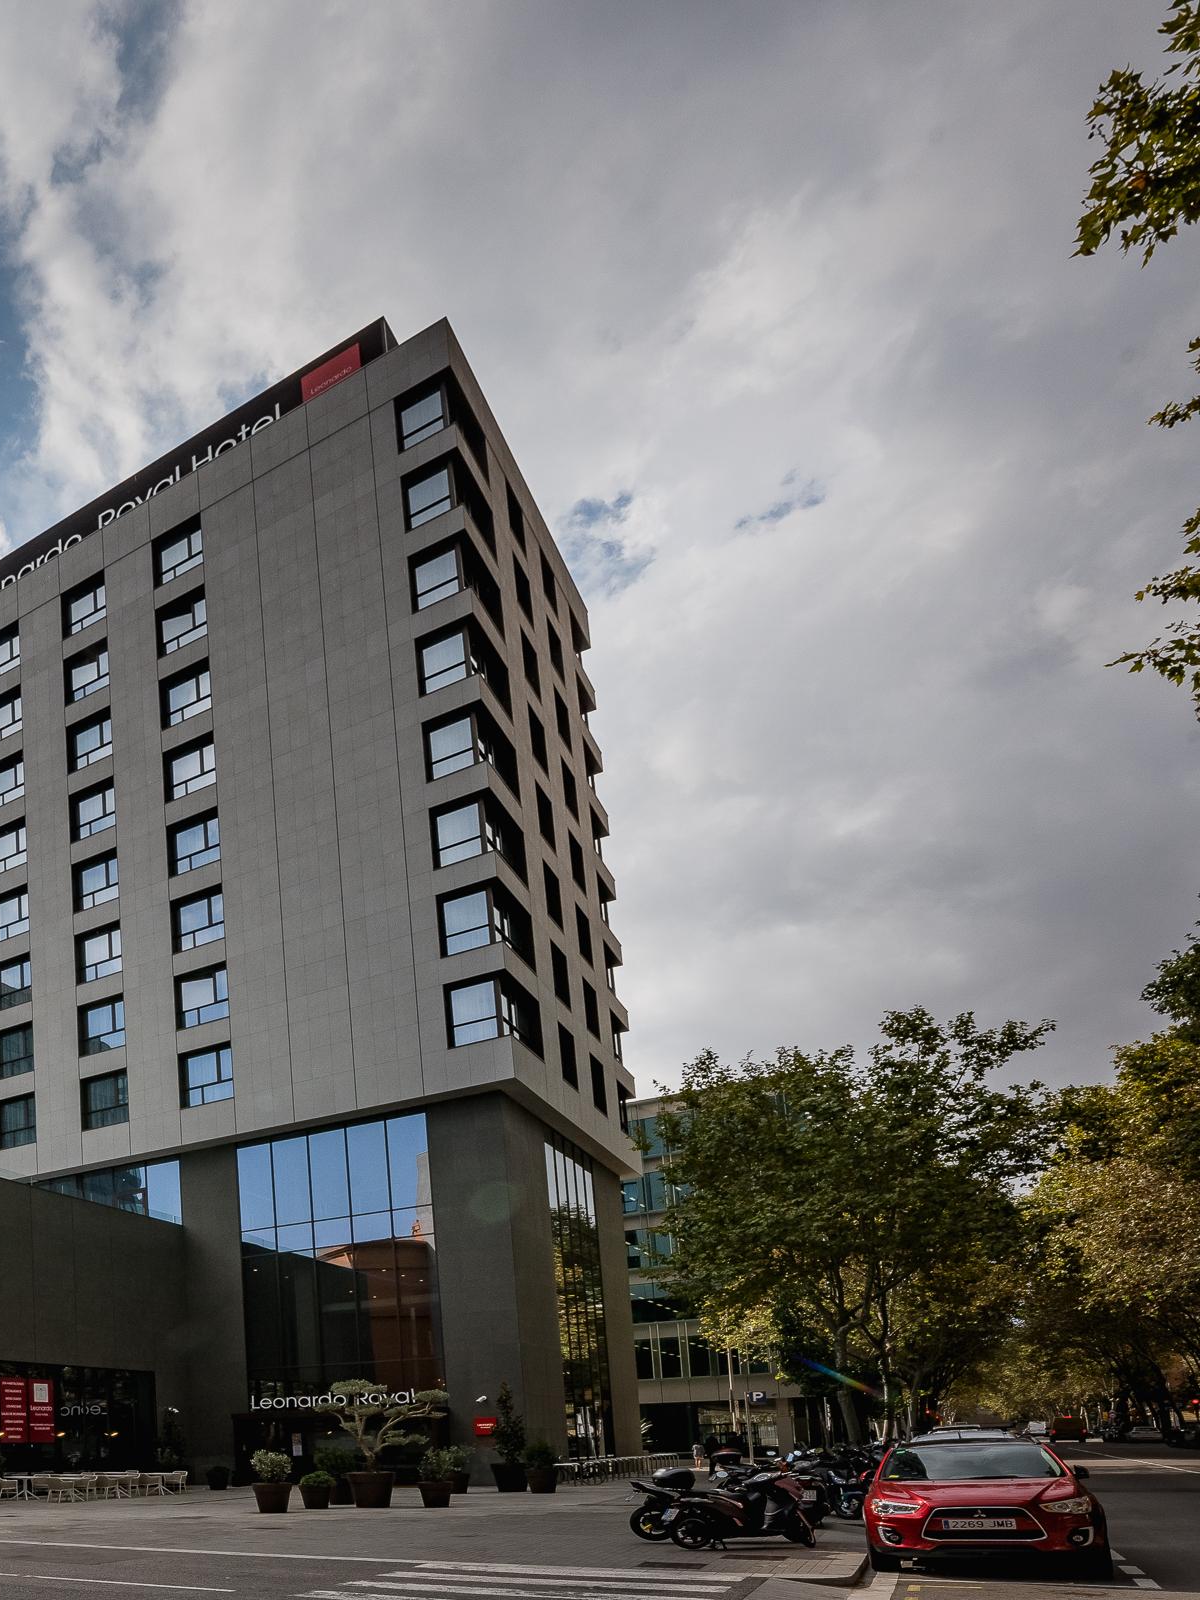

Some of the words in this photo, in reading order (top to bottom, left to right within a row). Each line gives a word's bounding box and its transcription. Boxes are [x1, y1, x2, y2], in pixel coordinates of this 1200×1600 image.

[310, 366, 353, 395] Leonardo
[191, 402, 281, 472] Hotel
[251, 1391, 347, 1410] Leonardo
[752, 1391, 764, 1402] P
[30, 1404, 53, 1412] Leonardo
[952, 1520, 984, 1529] 2269
[990, 1520, 1013, 1528] JMB
